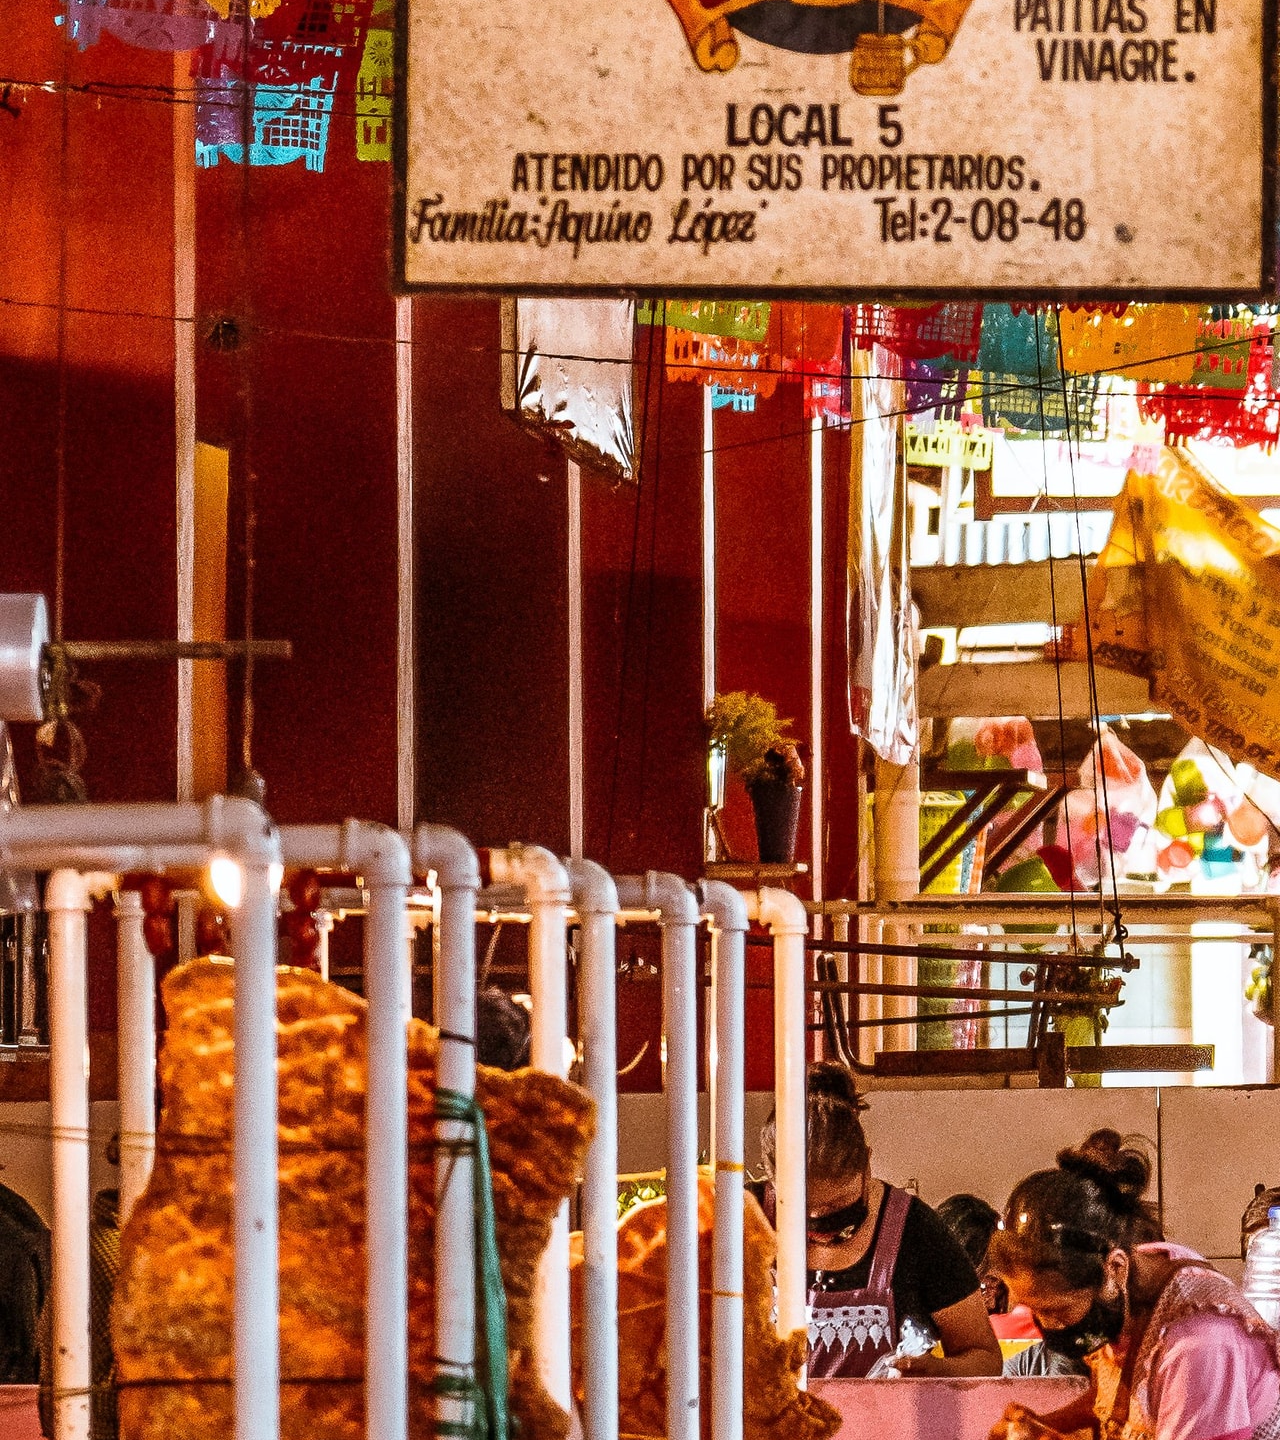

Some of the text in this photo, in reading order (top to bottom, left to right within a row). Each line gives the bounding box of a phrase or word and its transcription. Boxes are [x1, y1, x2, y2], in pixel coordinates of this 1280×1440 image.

[1035, 38, 1196, 83] VINAGRE.
[726, 103, 904, 149] LOCAL 5
[511, 152, 1041, 193] ATENDIDO POR SUS PROPIETARIOS.
[1203, 719, 1246, 751] TIPO
[1247, 742, 1275, 765] DE
